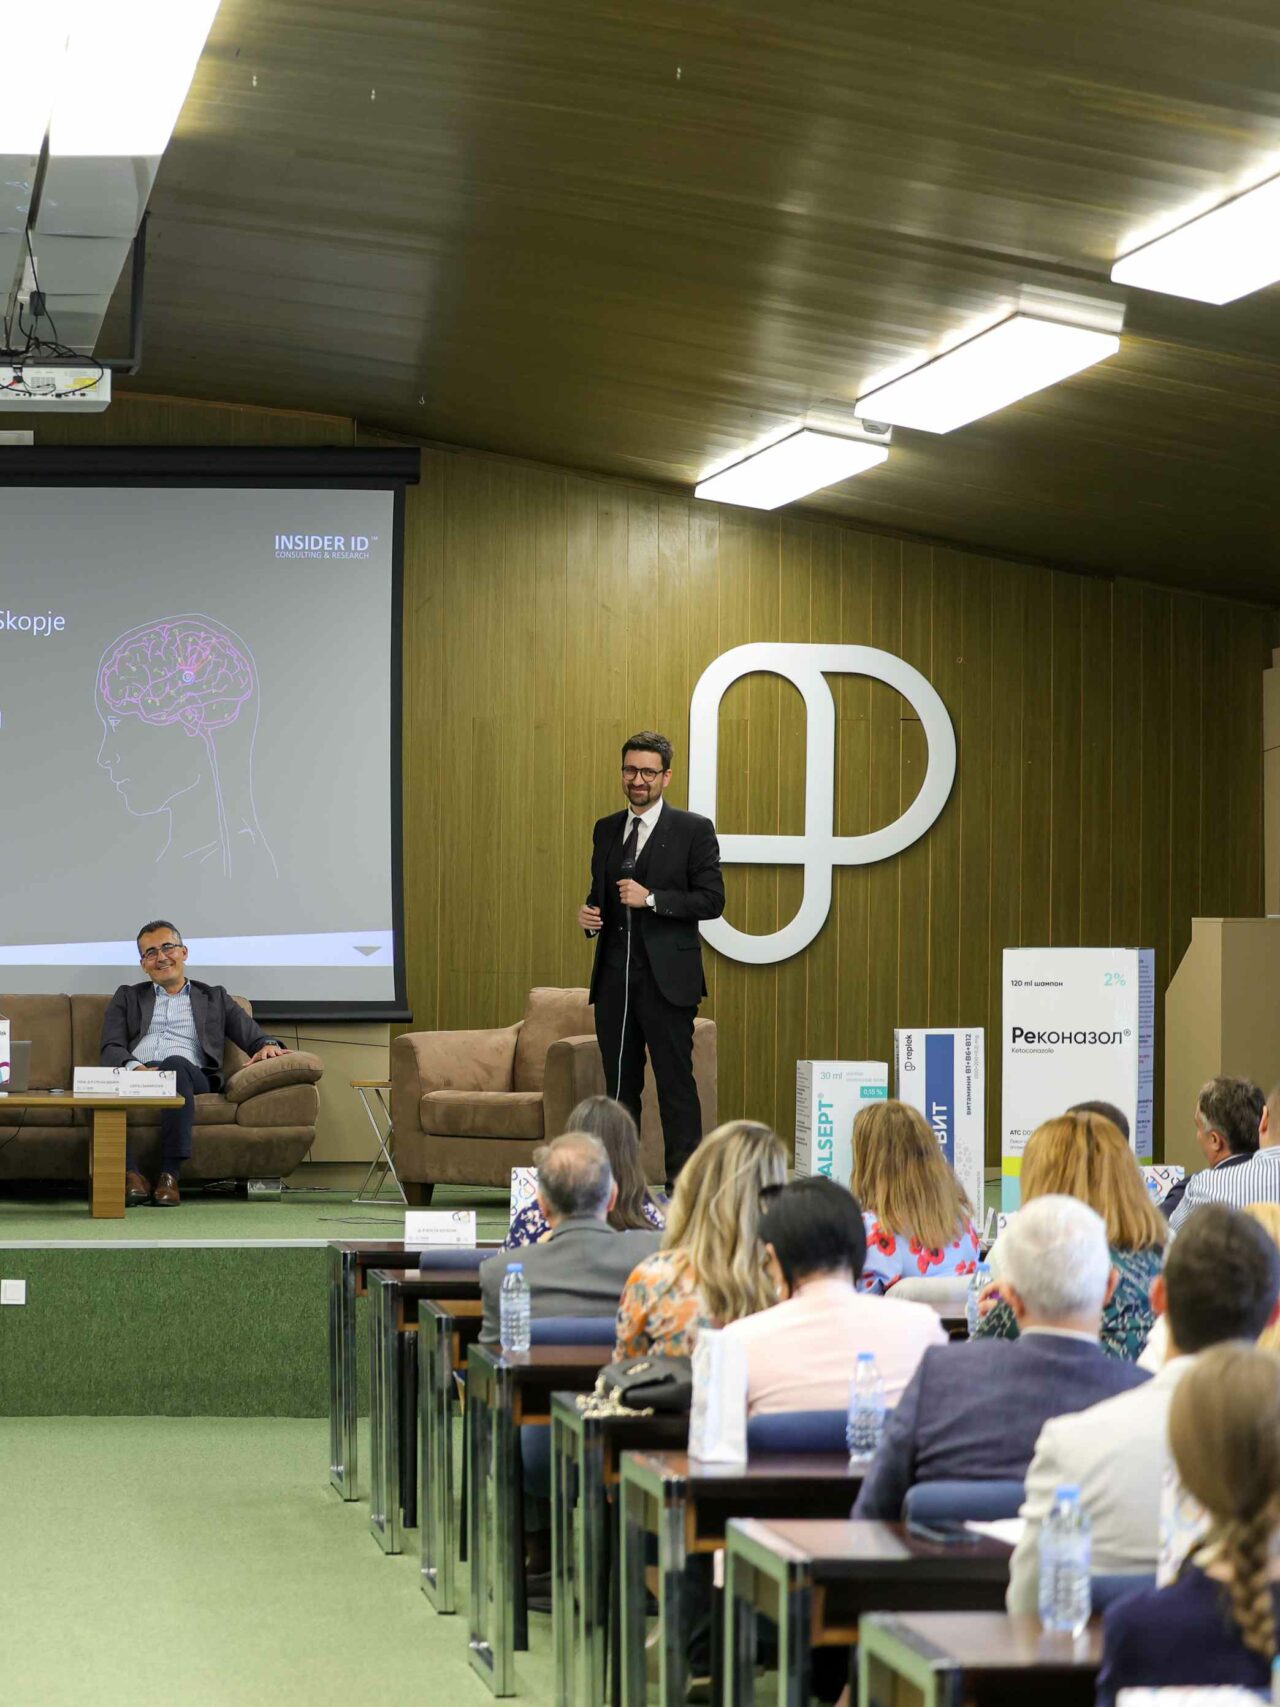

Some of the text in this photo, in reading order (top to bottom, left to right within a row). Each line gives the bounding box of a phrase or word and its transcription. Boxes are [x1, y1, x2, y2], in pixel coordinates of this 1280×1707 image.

[274, 535, 345, 550] INSIDER
[275, 551, 322, 559] CONSULTING
[331, 552, 370, 560] RESEARCH
[1103, 972, 1126, 987] 2%
[904, 1034, 914, 1060] replek
[820, 1072, 831, 1080] 30
[832, 1072, 843, 1080] ml
